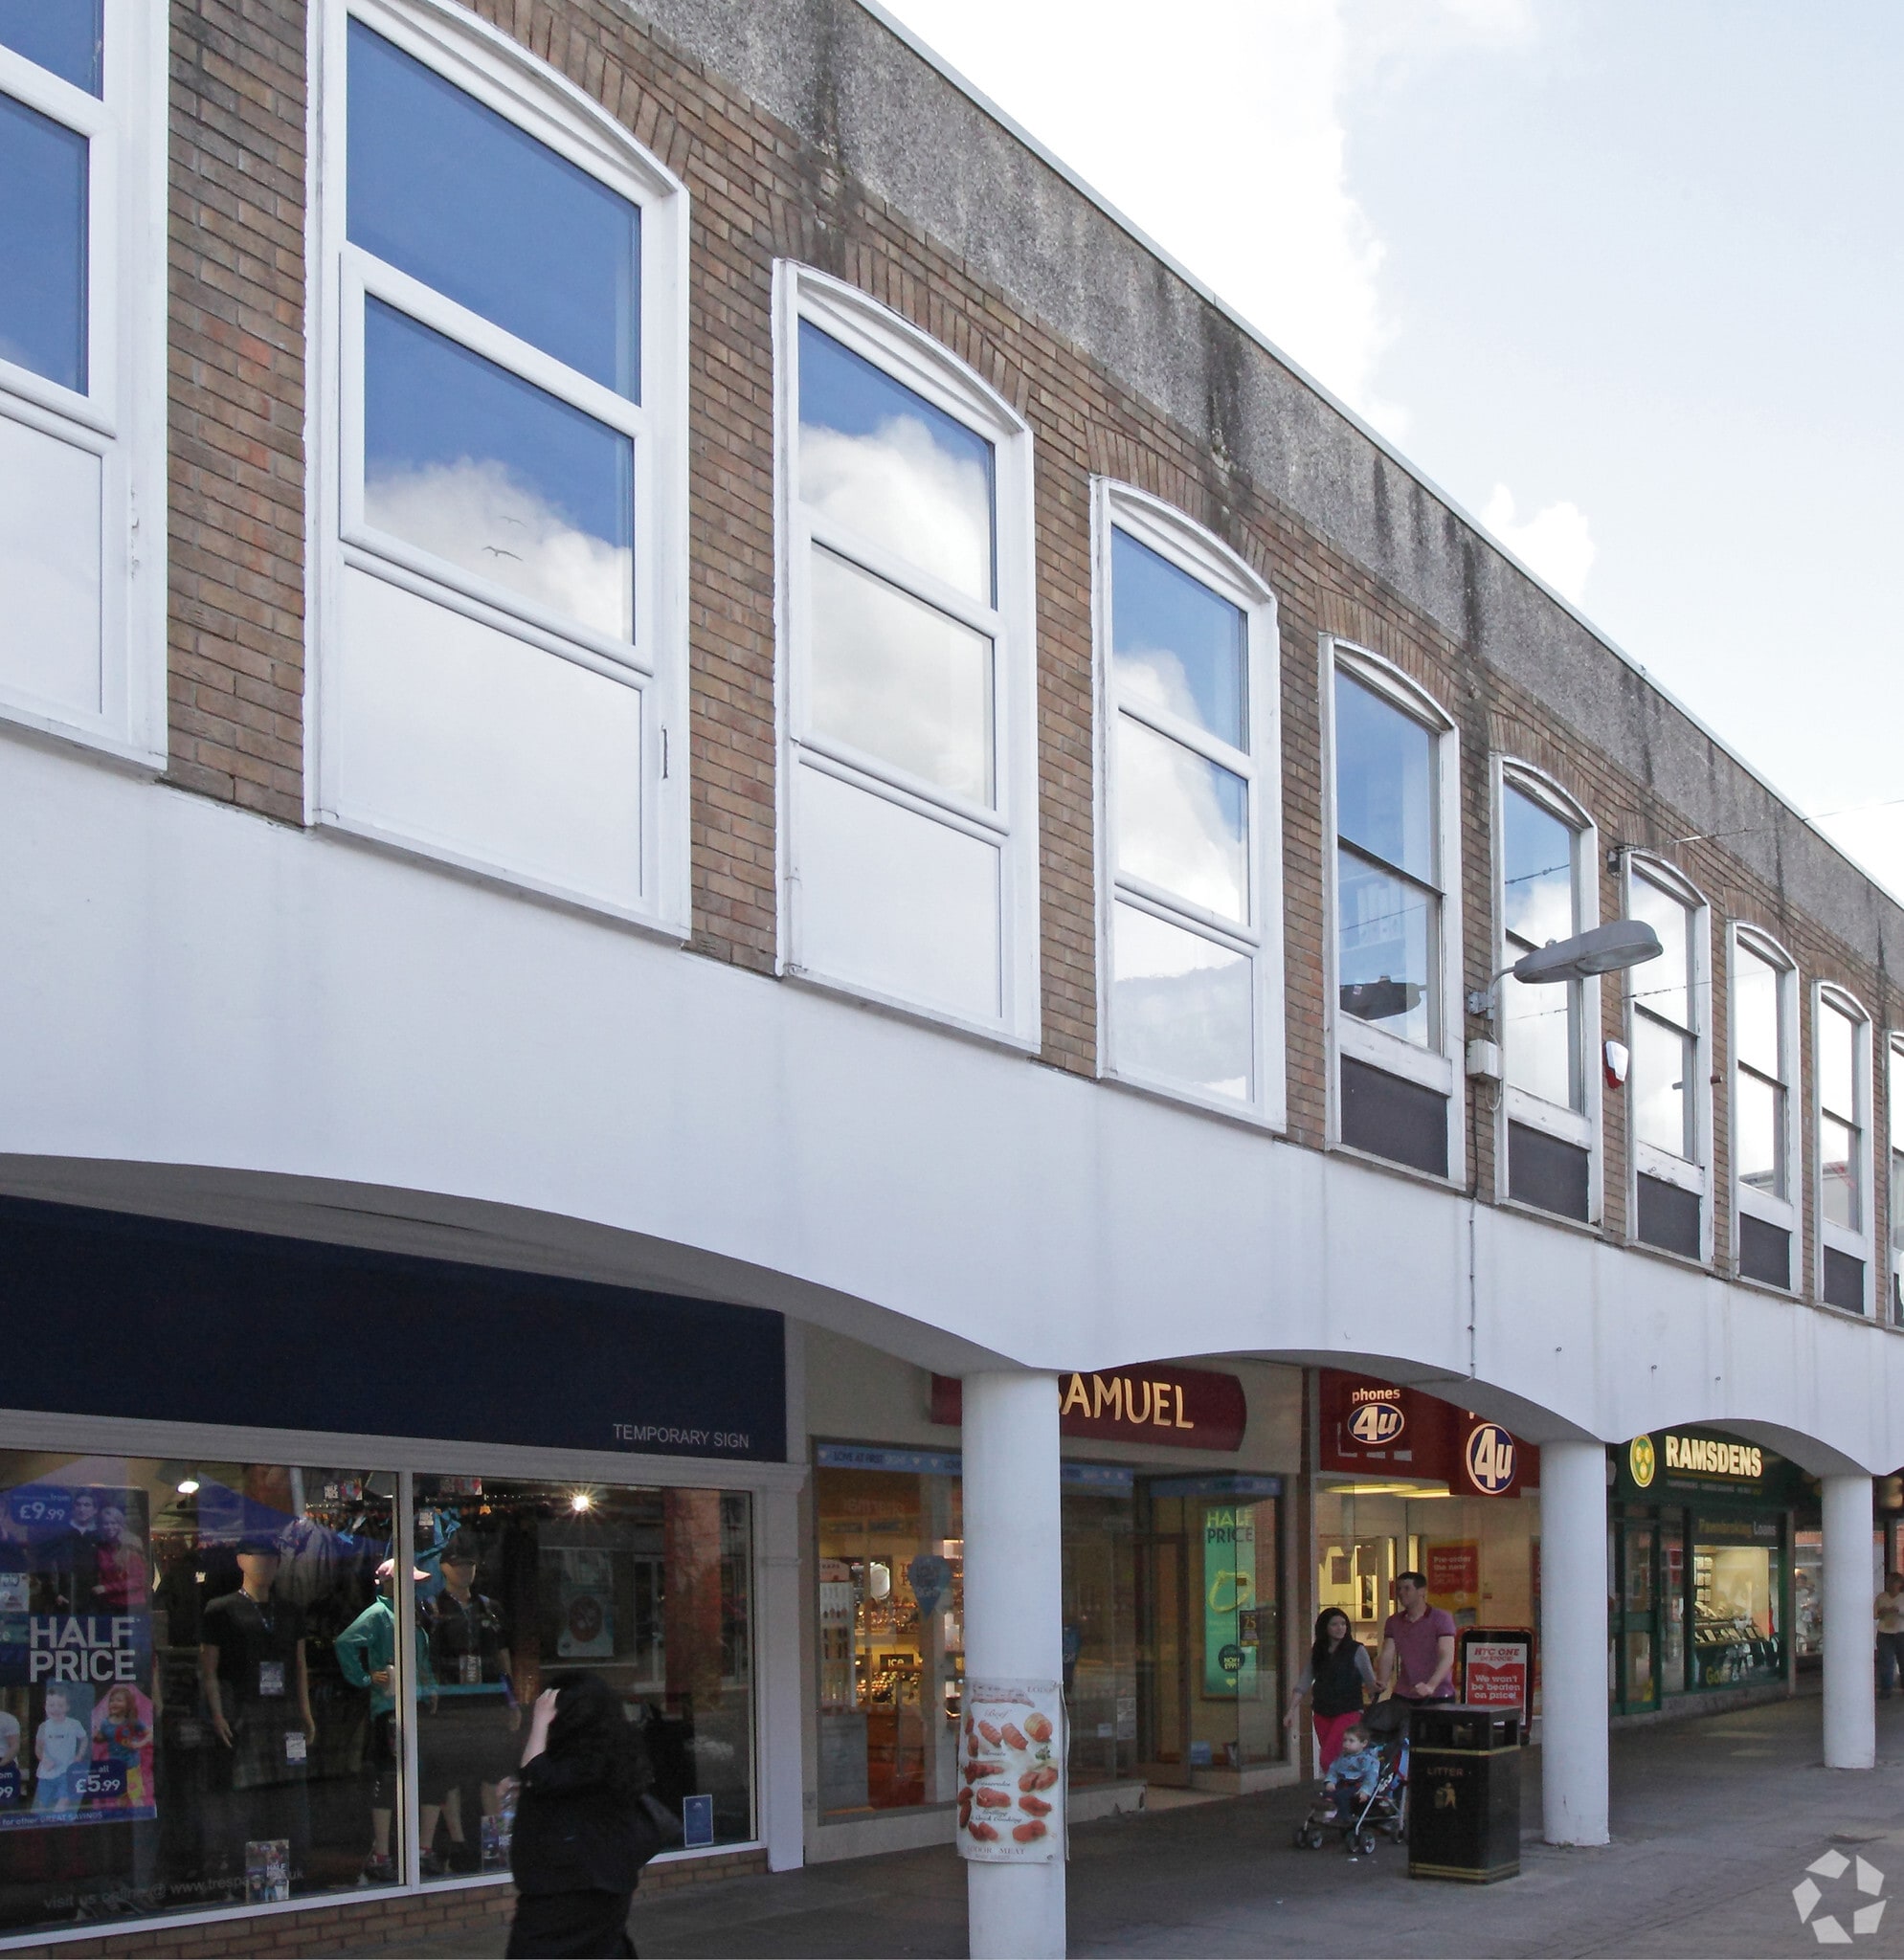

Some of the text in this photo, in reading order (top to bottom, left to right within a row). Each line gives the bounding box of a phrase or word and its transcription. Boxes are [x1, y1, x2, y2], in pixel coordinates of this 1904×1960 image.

[1058, 1372, 1195, 1429] AMUEL
[1352, 1388, 1400, 1404] phones
[613, 1423, 750, 1449] TEMPORARY SIGN
[1354, 1406, 1398, 1440] 4u
[1474, 1429, 1512, 1488] 4u
[1666, 1436, 1762, 1478] RAMSDENS
[20, 1502, 65, 1521] £9.99
[1206, 1509, 1254, 1527] HALF
[1207, 1526, 1254, 1544] PRICE
[30, 1616, 135, 1648] HALF
[30, 1650, 137, 1682] PRICE
[76, 1775, 121, 1793] £5.99
[1426, 1767, 1464, 1777] LITTER
